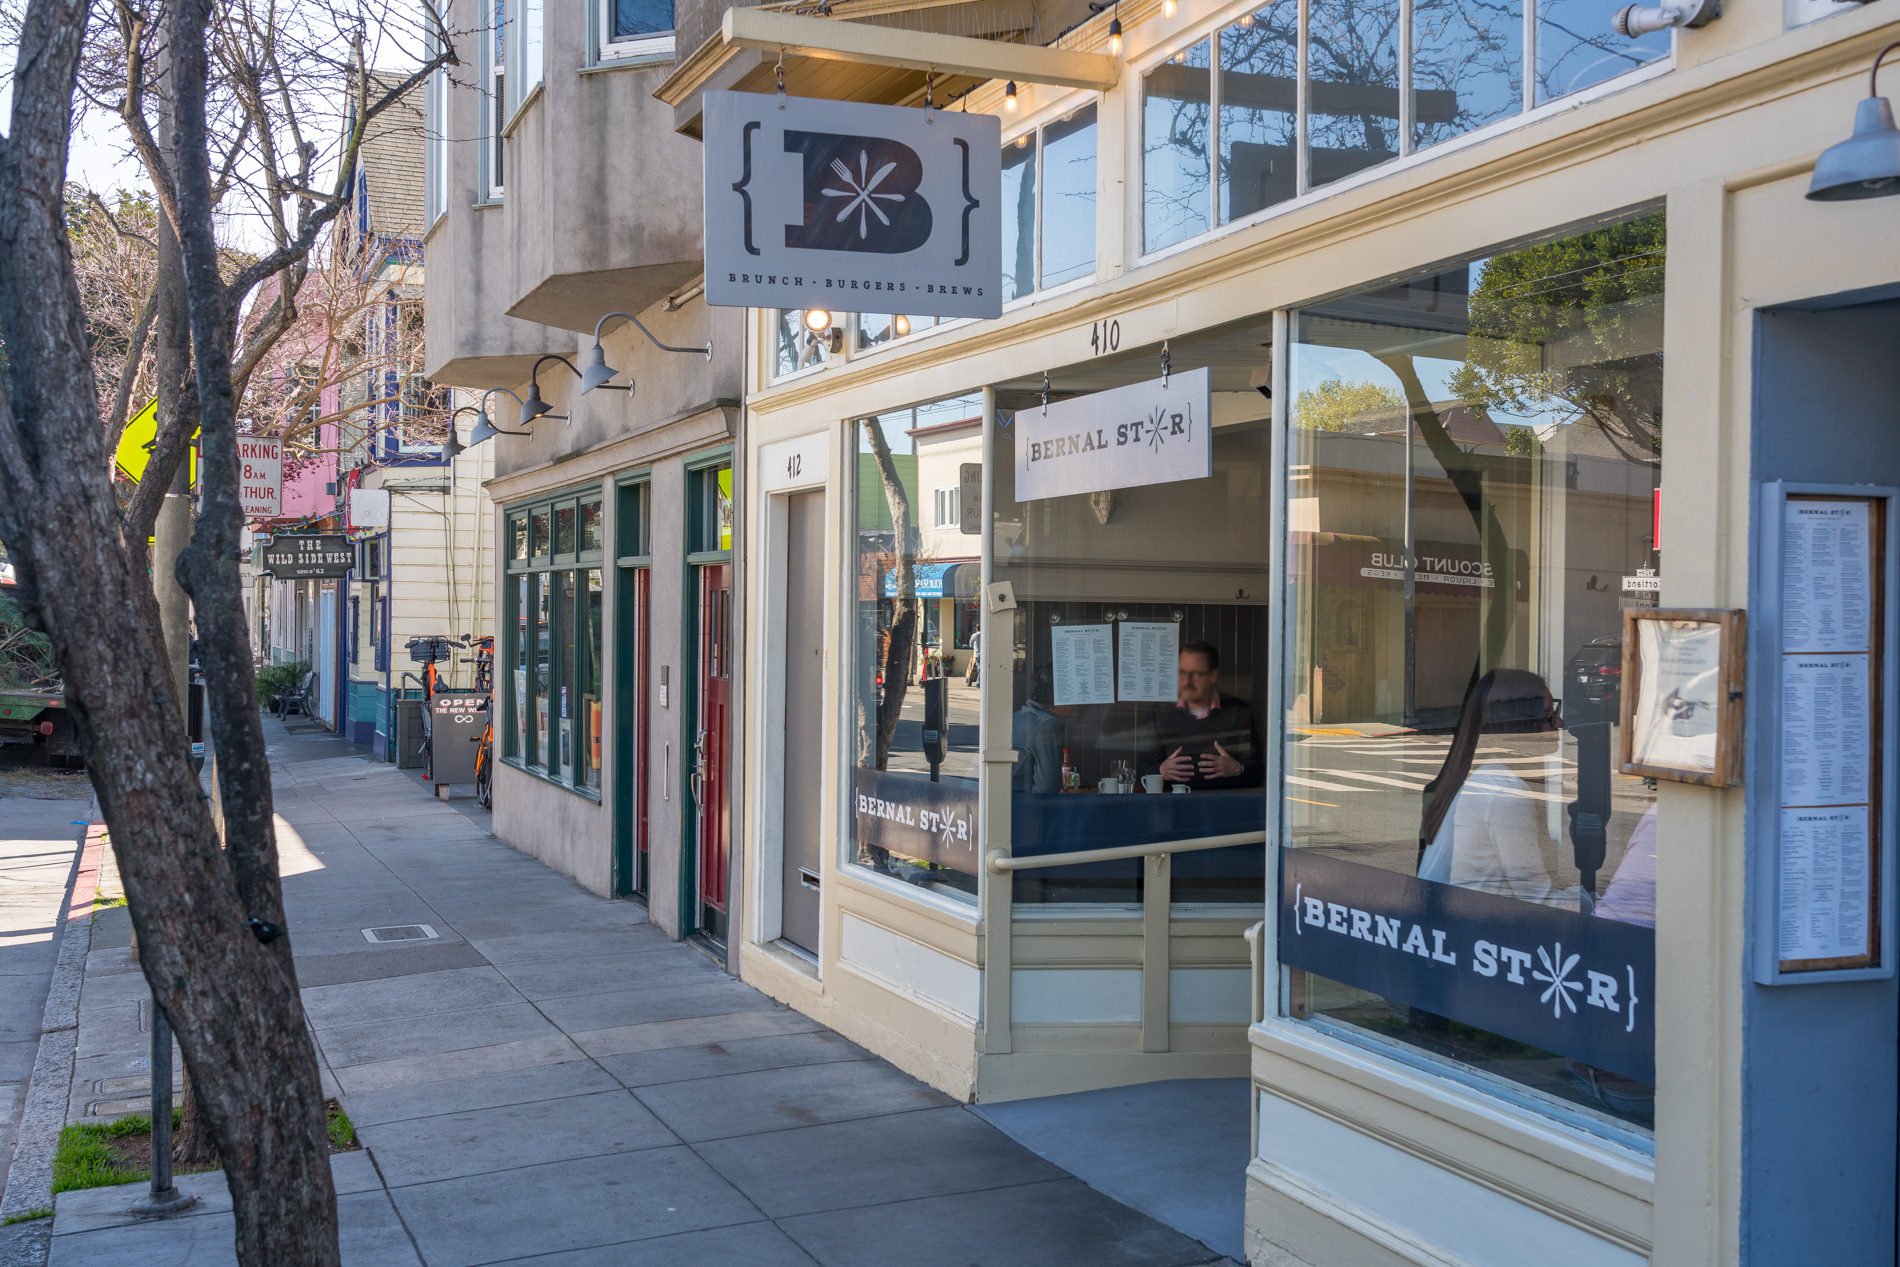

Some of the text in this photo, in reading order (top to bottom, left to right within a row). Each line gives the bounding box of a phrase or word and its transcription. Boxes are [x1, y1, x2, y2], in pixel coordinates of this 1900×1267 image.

[728, 273, 984, 297] BRUNCH BURGERS BREWS
[1091, 319, 1120, 356] 410
[236, 443, 278, 460] ARKING
[243, 464, 252, 479] 8
[787, 453, 801, 480] 412
[245, 505, 272, 514] EANING
[299, 540, 321, 551] THE
[267, 552, 352, 564] WILD SIDE WEST
